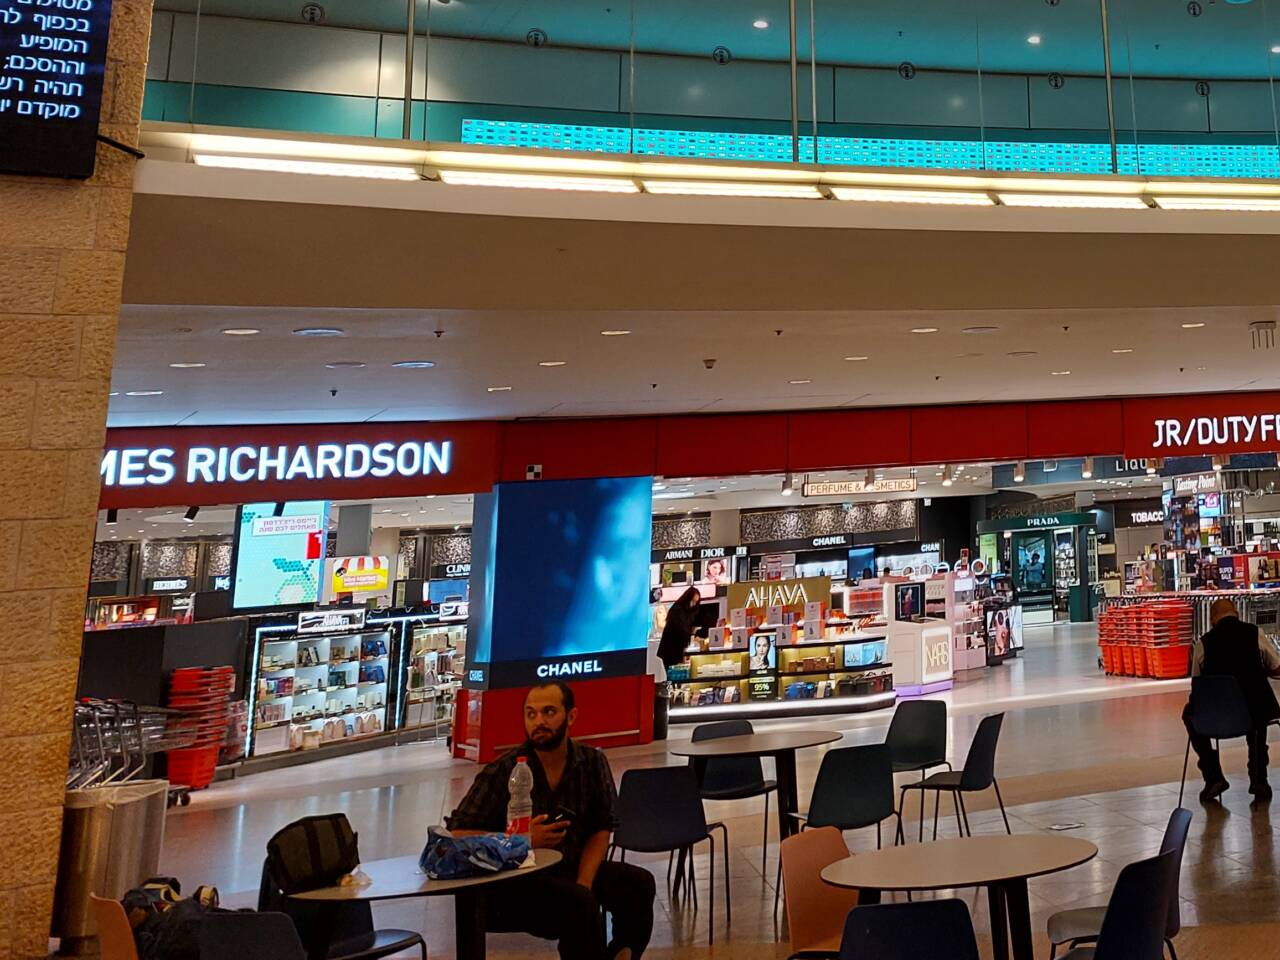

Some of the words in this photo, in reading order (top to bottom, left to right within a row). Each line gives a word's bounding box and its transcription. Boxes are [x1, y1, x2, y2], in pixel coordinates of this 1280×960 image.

[33, 13, 91, 32] בכפוף
[19, 34, 87, 53] המופיע
[34, 80, 83, 96] תהיה
[17, 100, 80, 119] מוקדם
[186, 440, 452, 483] RICHARDSON
[1115, 460, 1147, 472] LIQU
[809, 483, 853, 494] PERFUME
[1175, 477, 1198, 494] Tasting
[1198, 475, 1217, 488] Point
[1027, 517, 1060, 526] PRADA
[1131, 510, 1165, 524] TOBACC
[812, 535, 847, 547] CHANEL
[664, 548, 693, 560] ARMANI
[700, 547, 725, 558] DIOR
[745, 583, 809, 608] AHAVA
[925, 642, 949, 668] NARS
[537, 659, 602, 678] CHANEL
